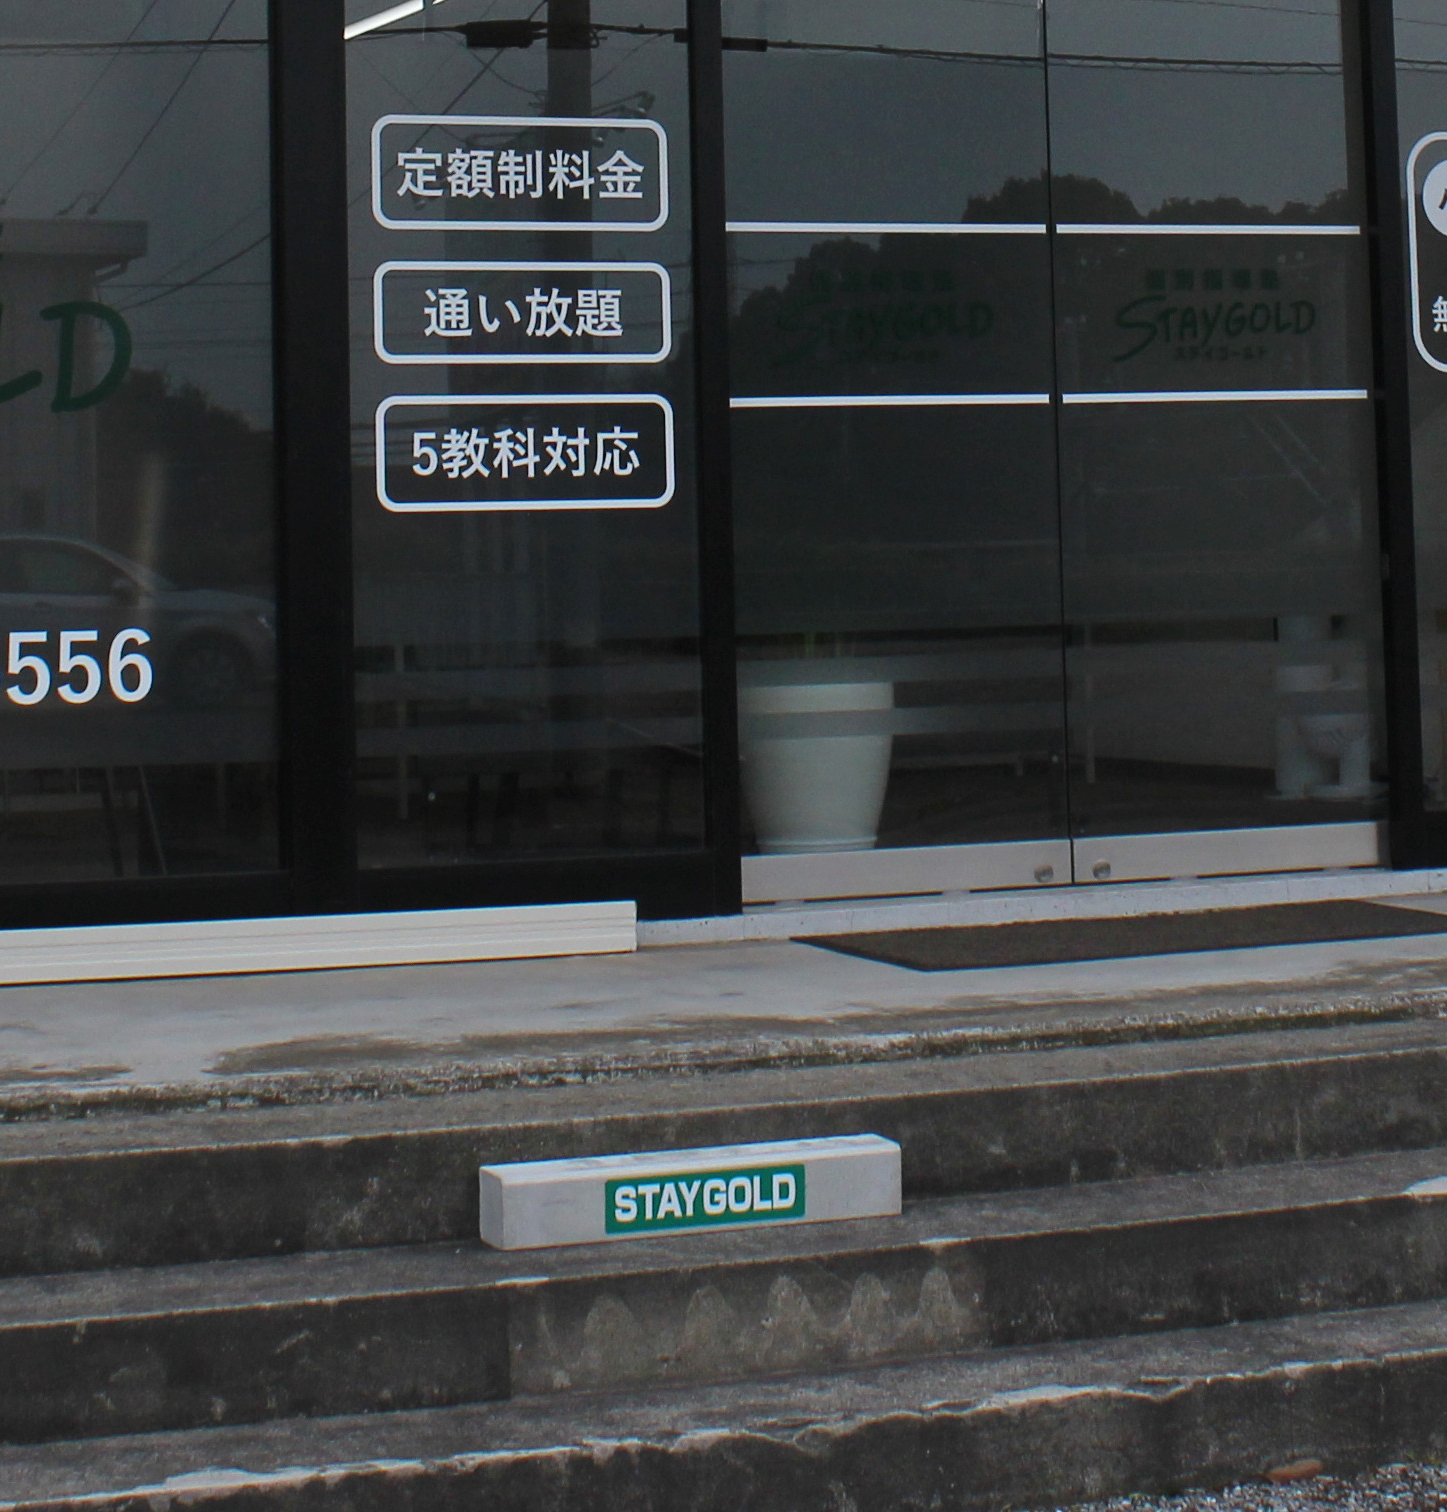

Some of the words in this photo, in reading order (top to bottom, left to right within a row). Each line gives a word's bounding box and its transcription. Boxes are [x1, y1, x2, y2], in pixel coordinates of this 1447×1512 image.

[396, 147, 646, 200] 定額制料金
[423, 287, 625, 338] 通い放題
[411, 426, 641, 479] 5教科対応
[613, 1172, 798, 1224] STAYGOLD
